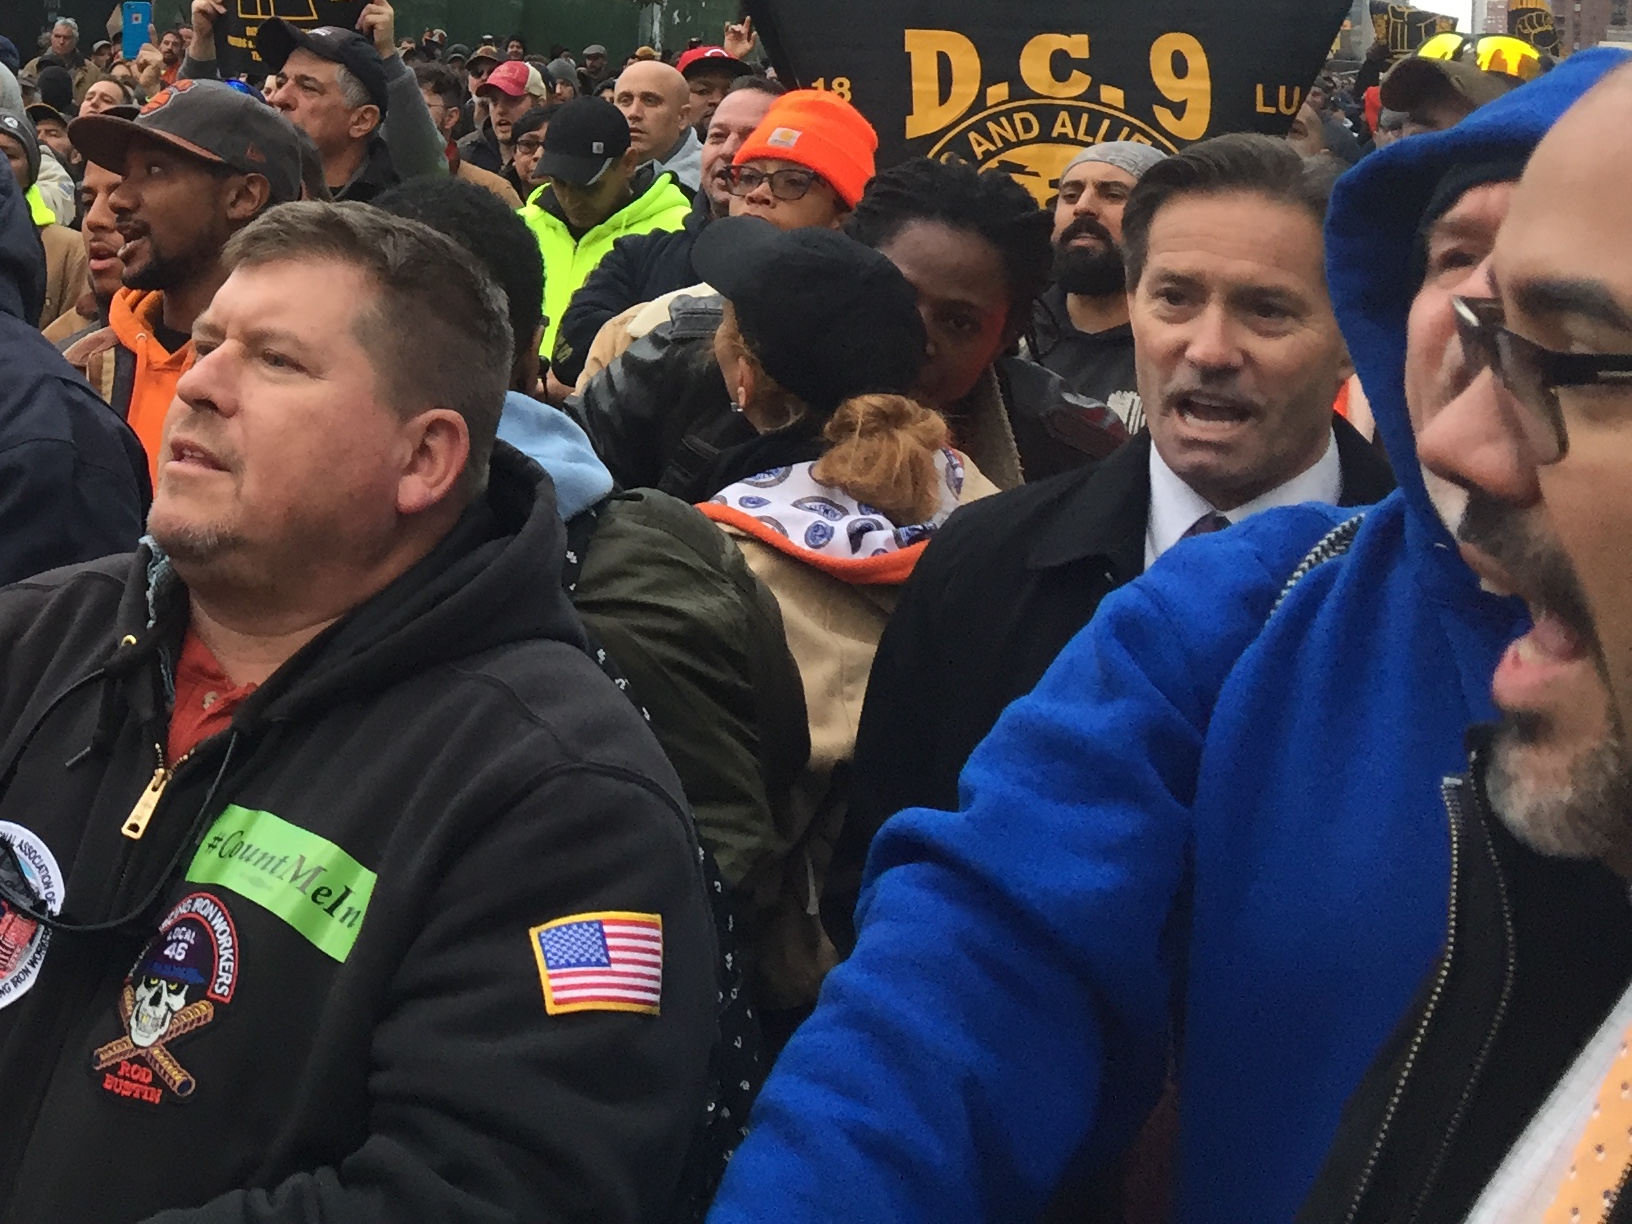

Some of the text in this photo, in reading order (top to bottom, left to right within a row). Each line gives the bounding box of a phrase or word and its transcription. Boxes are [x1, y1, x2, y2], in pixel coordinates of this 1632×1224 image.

[1256, 83, 1301, 115] LU
[968, 111, 1040, 160] AND
[17, 839, 54, 891] ASSOCIATION
[45, 891, 57, 906] OF
[206, 830, 362, 929] #CountMeIn
[166, 926, 196, 945] LOCAL
[164, 942, 188, 961] 46
[12, 966, 32, 988] IRON
[117, 1060, 153, 1083] ROD
